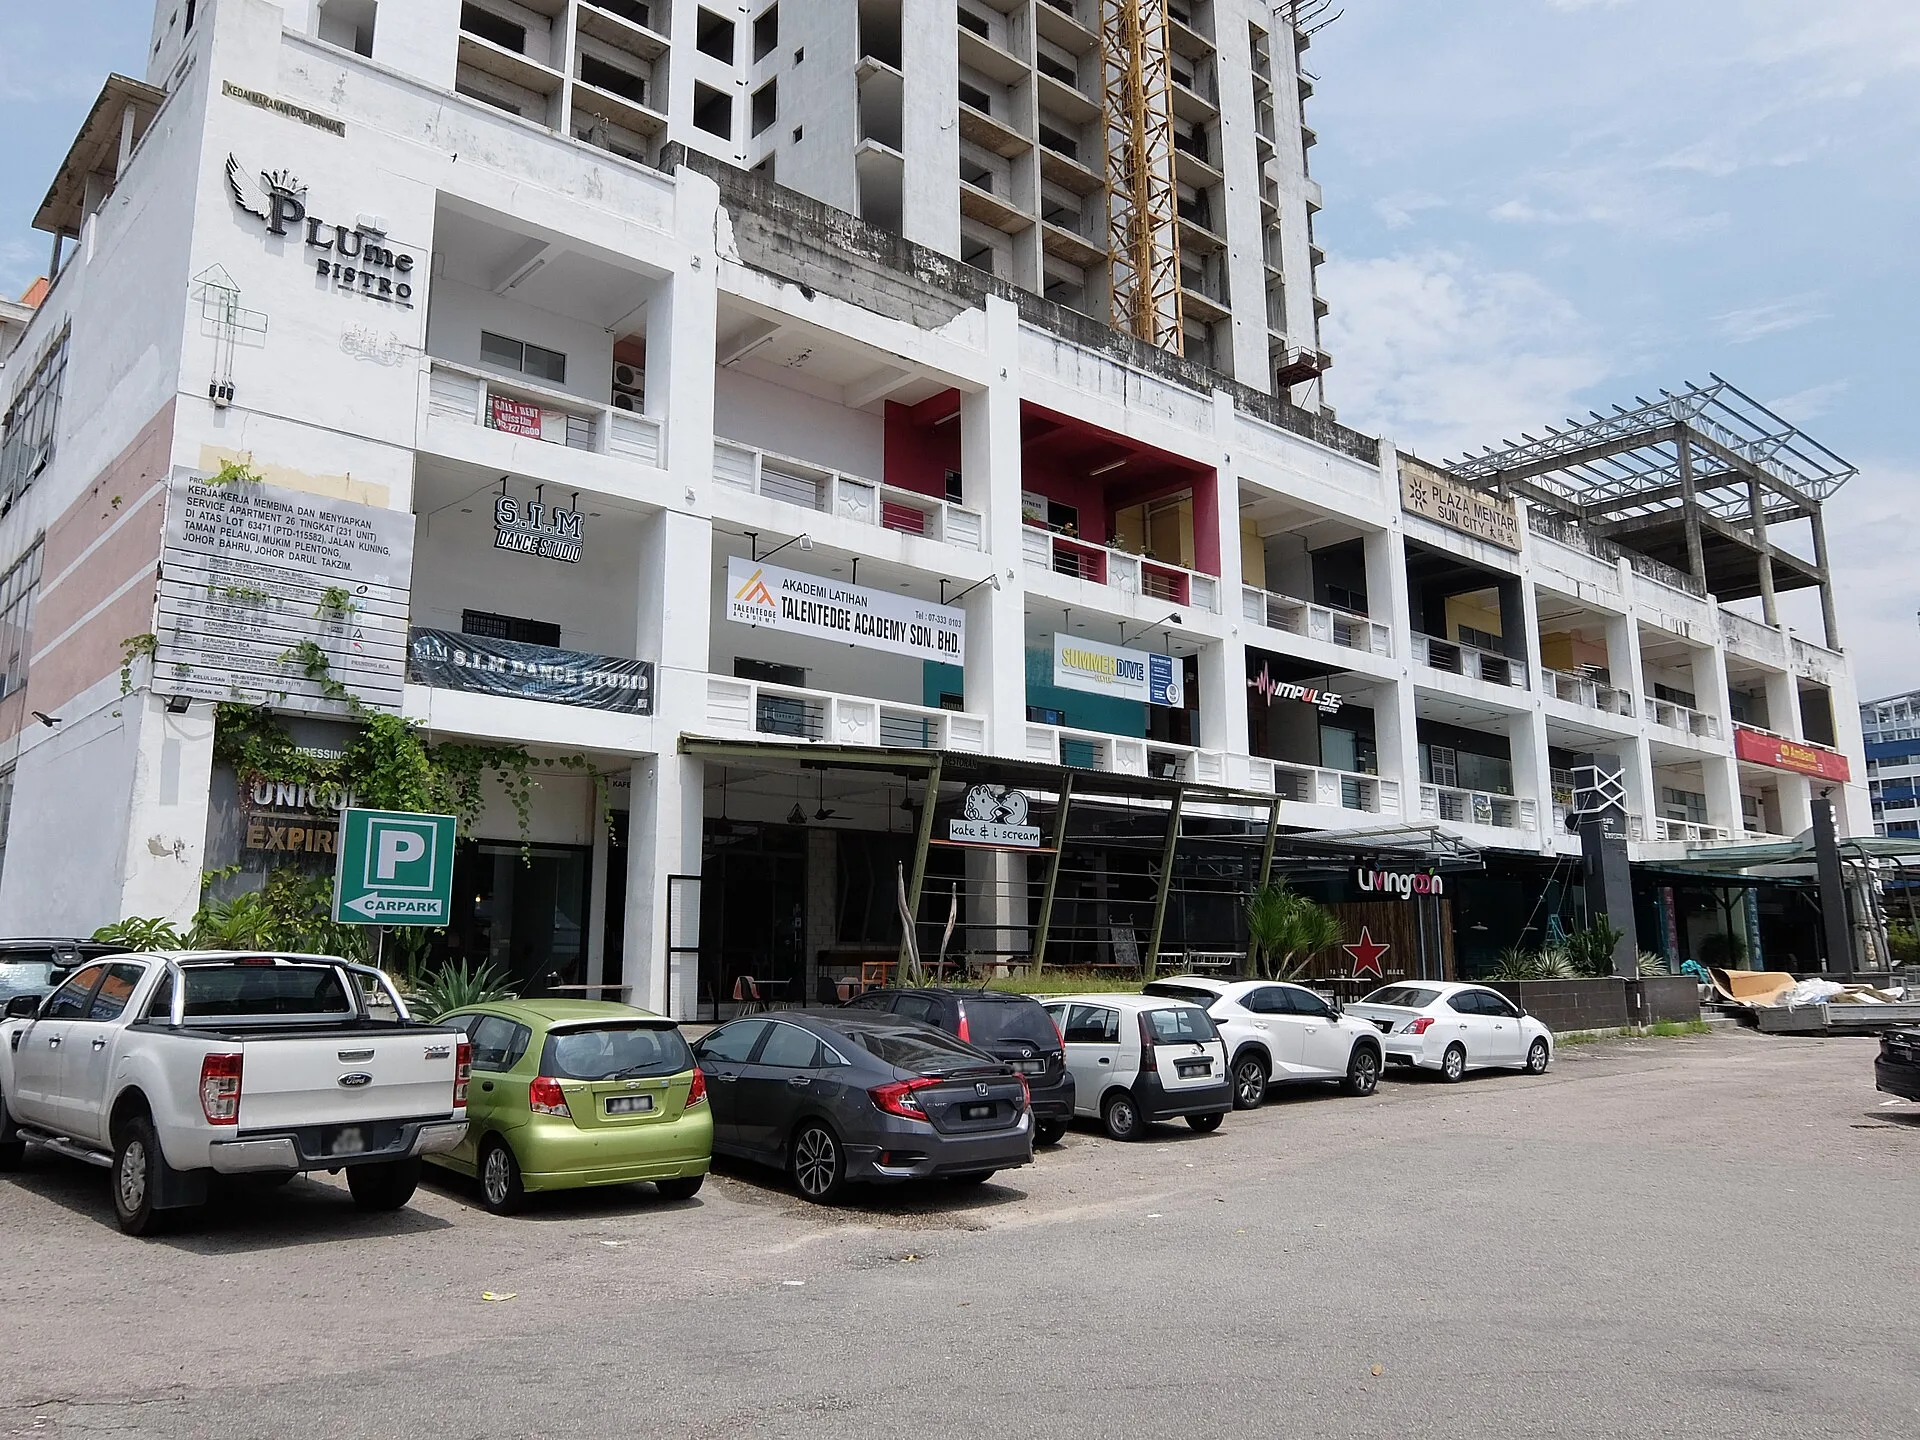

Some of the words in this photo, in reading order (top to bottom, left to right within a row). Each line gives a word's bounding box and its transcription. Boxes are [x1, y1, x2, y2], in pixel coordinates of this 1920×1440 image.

[228, 85, 250, 101] KEDAI
[316, 258, 412, 298] BISTRO
[520, 406, 538, 418] RENT
[186, 497, 226, 512] SERVICE
[229, 505, 282, 523] APARTMENT
[286, 516, 296, 526] 26
[300, 518, 334, 533] TINGKAT
[336, 527, 352, 536] (231
[356, 531, 377, 543] UNIT)
[188, 485, 250, 506] KERJA-KERJA
[254, 498, 294, 514] MEMBINA
[298, 506, 316, 518] DAN
[319, 512, 372, 530] MENYIAPKAN
[1432, 486, 1470, 514] PLAZA
[1474, 503, 1518, 534] MENTARI
[1438, 506, 1459, 524] SUN
[1463, 516, 1485, 534] CITY
[184, 520, 216, 534] TAMAN
[262, 536, 290, 548] MUKIM
[186, 508, 195, 518] DI
[199, 512, 222, 523] ATAS
[226, 516, 244, 527] LOT
[248, 521, 271, 533] 63471
[328, 537, 354, 549] JALAN
[182, 532, 214, 546] JOHOR
[220, 539, 252, 554] BAHRU,
[254, 546, 284, 559] JOHOR
[289, 552, 317, 564] DARUL
[497, 530, 540, 554] DANCE
[540, 539, 582, 562] STUDIO
[782, 578, 826, 598] AKADEMI
[829, 588, 868, 608] LATIHAN
[734, 603, 776, 618] TALENTEDGE
[782, 596, 851, 632] TALENTEDGE
[854, 612, 907, 643] ACADEMY
[910, 624, 934, 648] SDN.
[938, 630, 960, 654] BHD.
[915, 610, 924, 620] Tel
[928, 614, 946, 624] 07-333
[948, 618, 962, 628] 0103
[511, 660, 577, 684] DANCE
[582, 671, 648, 690] STUDIO
[1274, 682, 1342, 708] IMPULSE
[952, 824, 976, 837] kate
[980, 826, 989, 840] &
[1002, 830, 1038, 841] scream
[377, 830, 425, 880] P
[364, 900, 438, 913] CARPARK
[346, 1076, 366, 1084] Ford
